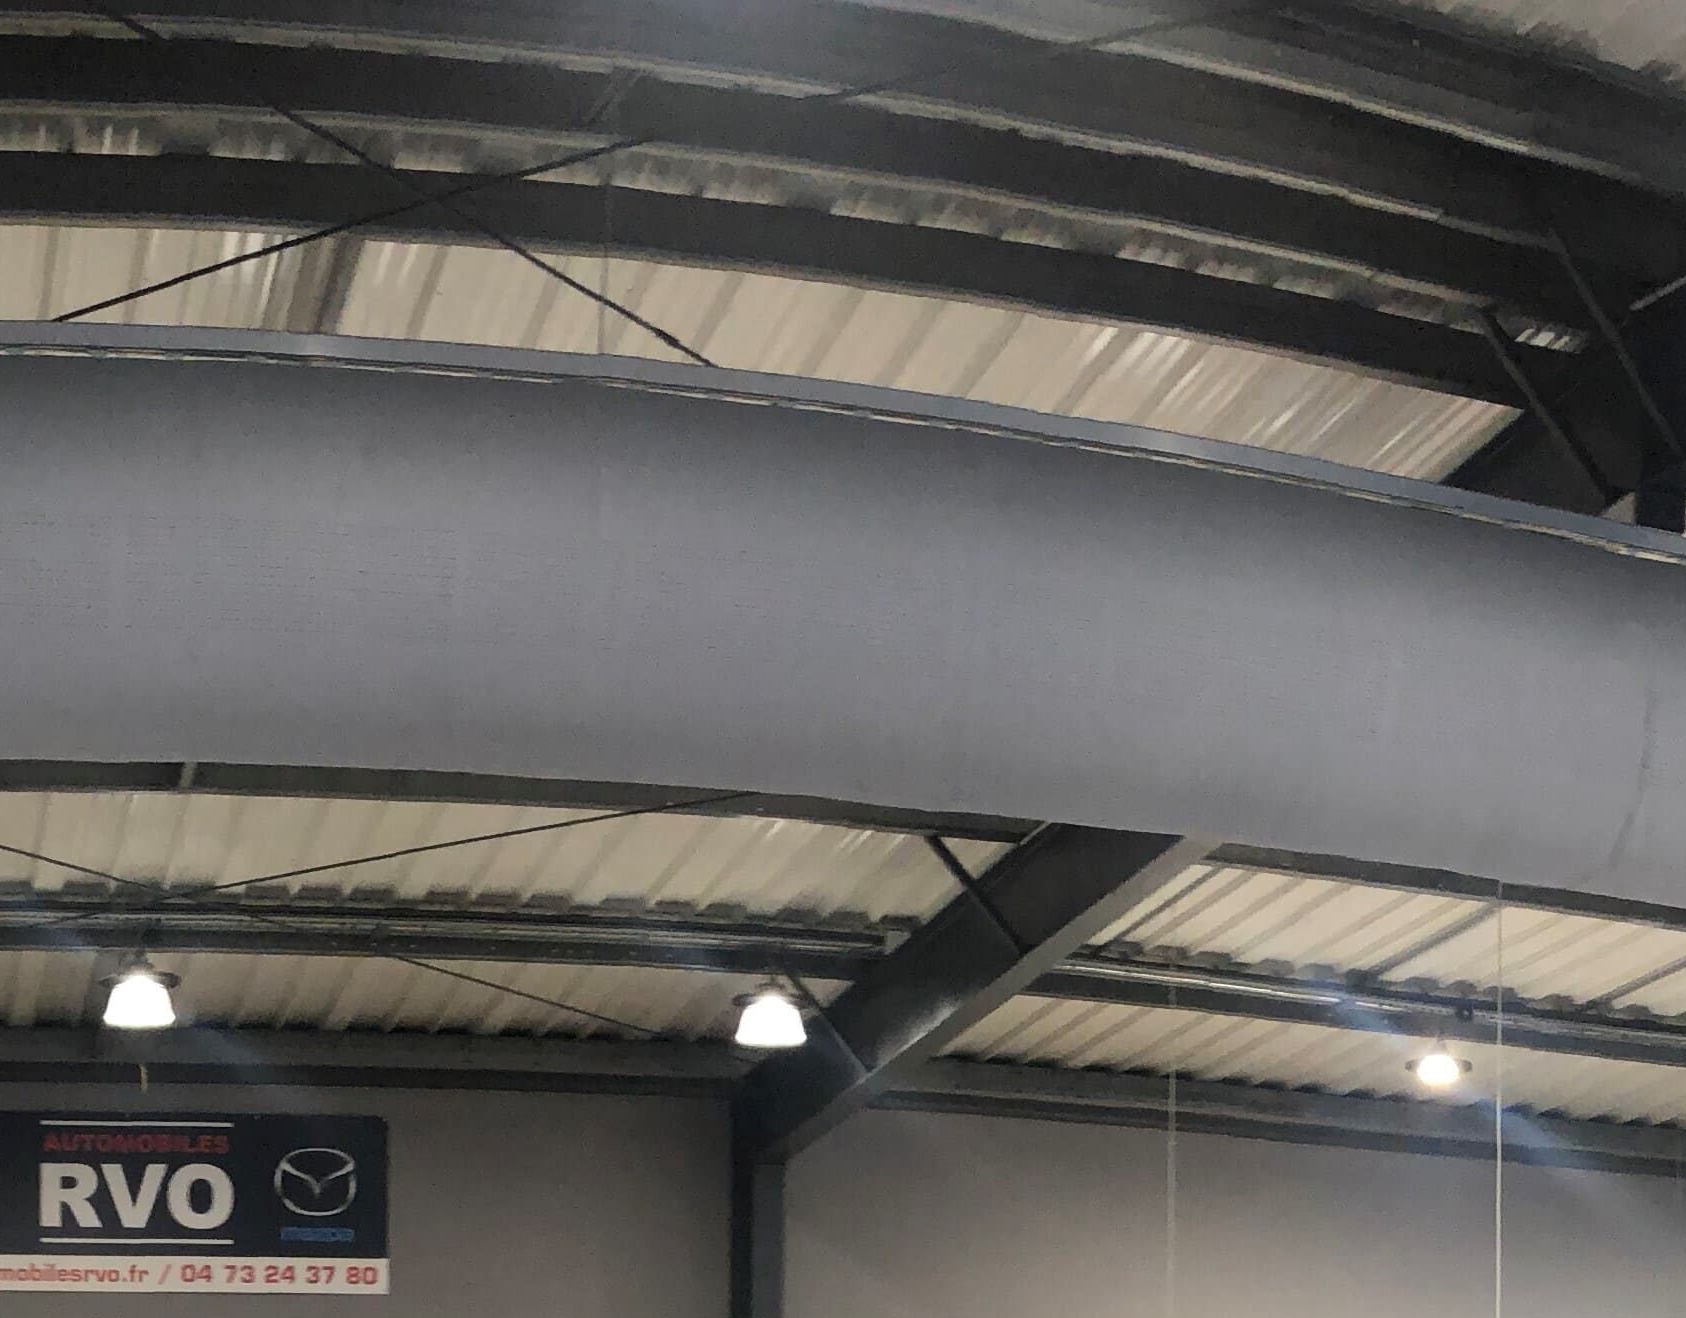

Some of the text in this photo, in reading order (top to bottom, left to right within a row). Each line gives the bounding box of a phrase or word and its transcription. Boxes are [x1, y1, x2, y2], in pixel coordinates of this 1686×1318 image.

[43, 1133, 230, 1154] AUTOMOBILES
[39, 1162, 235, 1230] RVO
[180, 1264, 213, 1284] 04
[225, 1264, 256, 1285] 73
[264, 1265, 296, 1285] 24
[306, 1265, 336, 1285] 37
[345, 1266, 378, 1286] 80
